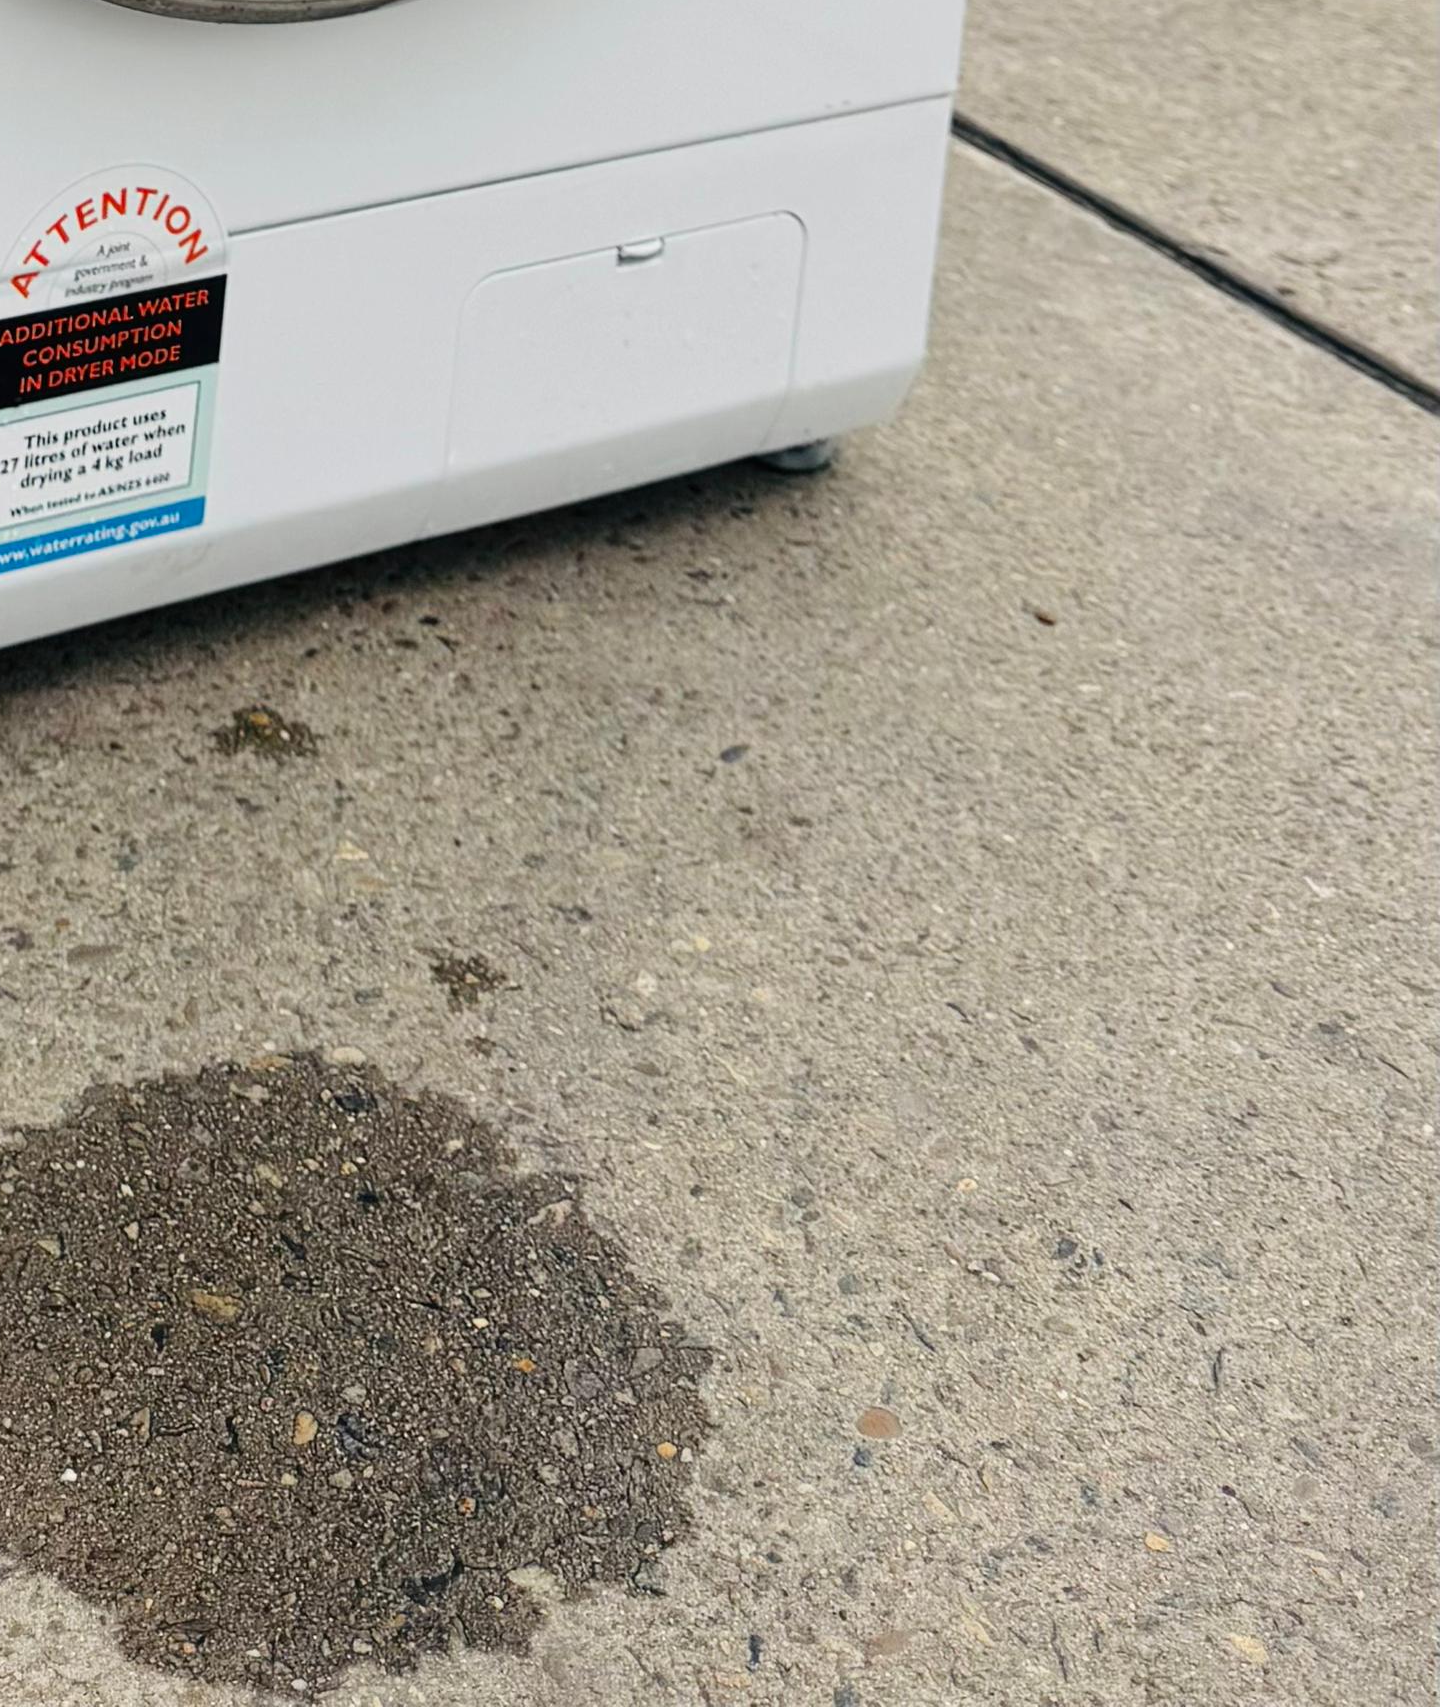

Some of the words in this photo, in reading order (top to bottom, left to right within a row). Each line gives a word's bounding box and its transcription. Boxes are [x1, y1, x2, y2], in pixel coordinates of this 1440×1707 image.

[10, 187, 208, 299] ATTENTION
[139, 289, 209, 315] WATER
[23, 319, 182, 367] CONSUMPTION
[19, 375, 42, 393] IN
[48, 359, 114, 387] DRYER
[120, 345, 181, 371] MODE
[0, 458, 18, 475] 27
[24, 449, 65, 469] litres
[71, 443, 86, 457] of
[92, 435, 139, 453] water
[144, 423, 186, 443] when
[24, 433, 58, 449] This
[64, 417, 128, 444] product
[132, 409, 166, 426] uses
[20, 465, 72, 489] drying
[78, 465, 86, 475] a
[92, 459, 101, 471] 4
[106, 453, 123, 471] kg
[129, 445, 162, 465] load
